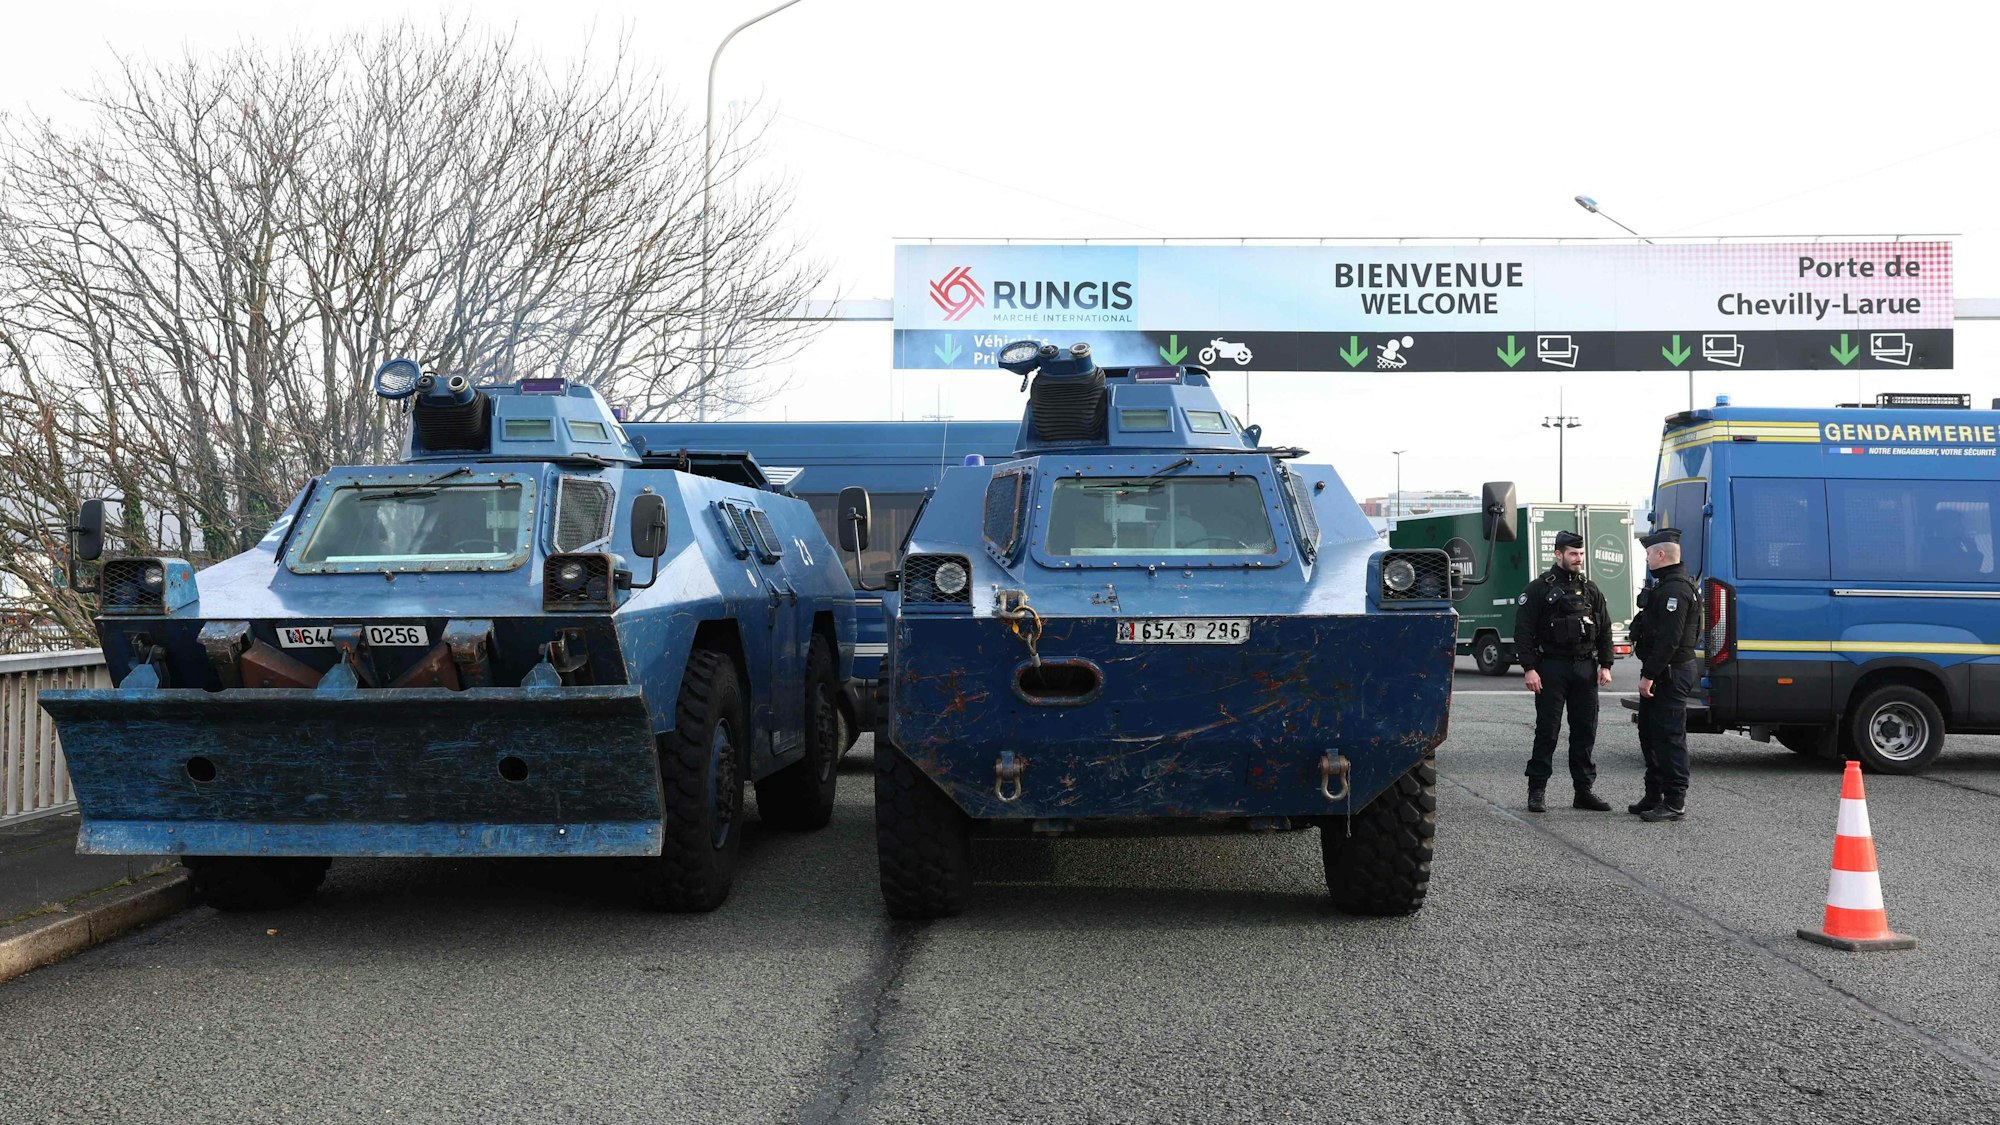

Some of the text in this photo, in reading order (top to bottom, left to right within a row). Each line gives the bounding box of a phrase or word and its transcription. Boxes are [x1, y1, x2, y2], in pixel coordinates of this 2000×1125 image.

[1335, 262, 1524, 288] BIENVENUE
[1798, 255, 1920, 278] Porte de
[993, 281, 1133, 311] RUNGIS
[1361, 293, 1498, 315] WELCOME
[1717, 292, 1921, 321] Chevilly-Larue
[993, 313, 1133, 323] MARCHÉ INTERNATIONAL
[974, 334, 1049, 348] Véhis
[1824, 423, 1997, 443] GENDARMERIE
[1869, 447, 1997, 456] NOTRE ENGAGEMENT, VOTRE SÉCURITÉ
[371, 627, 419, 644] 0256
[1142, 623, 1174, 639] 654
[1207, 622, 1240, 639] 296
